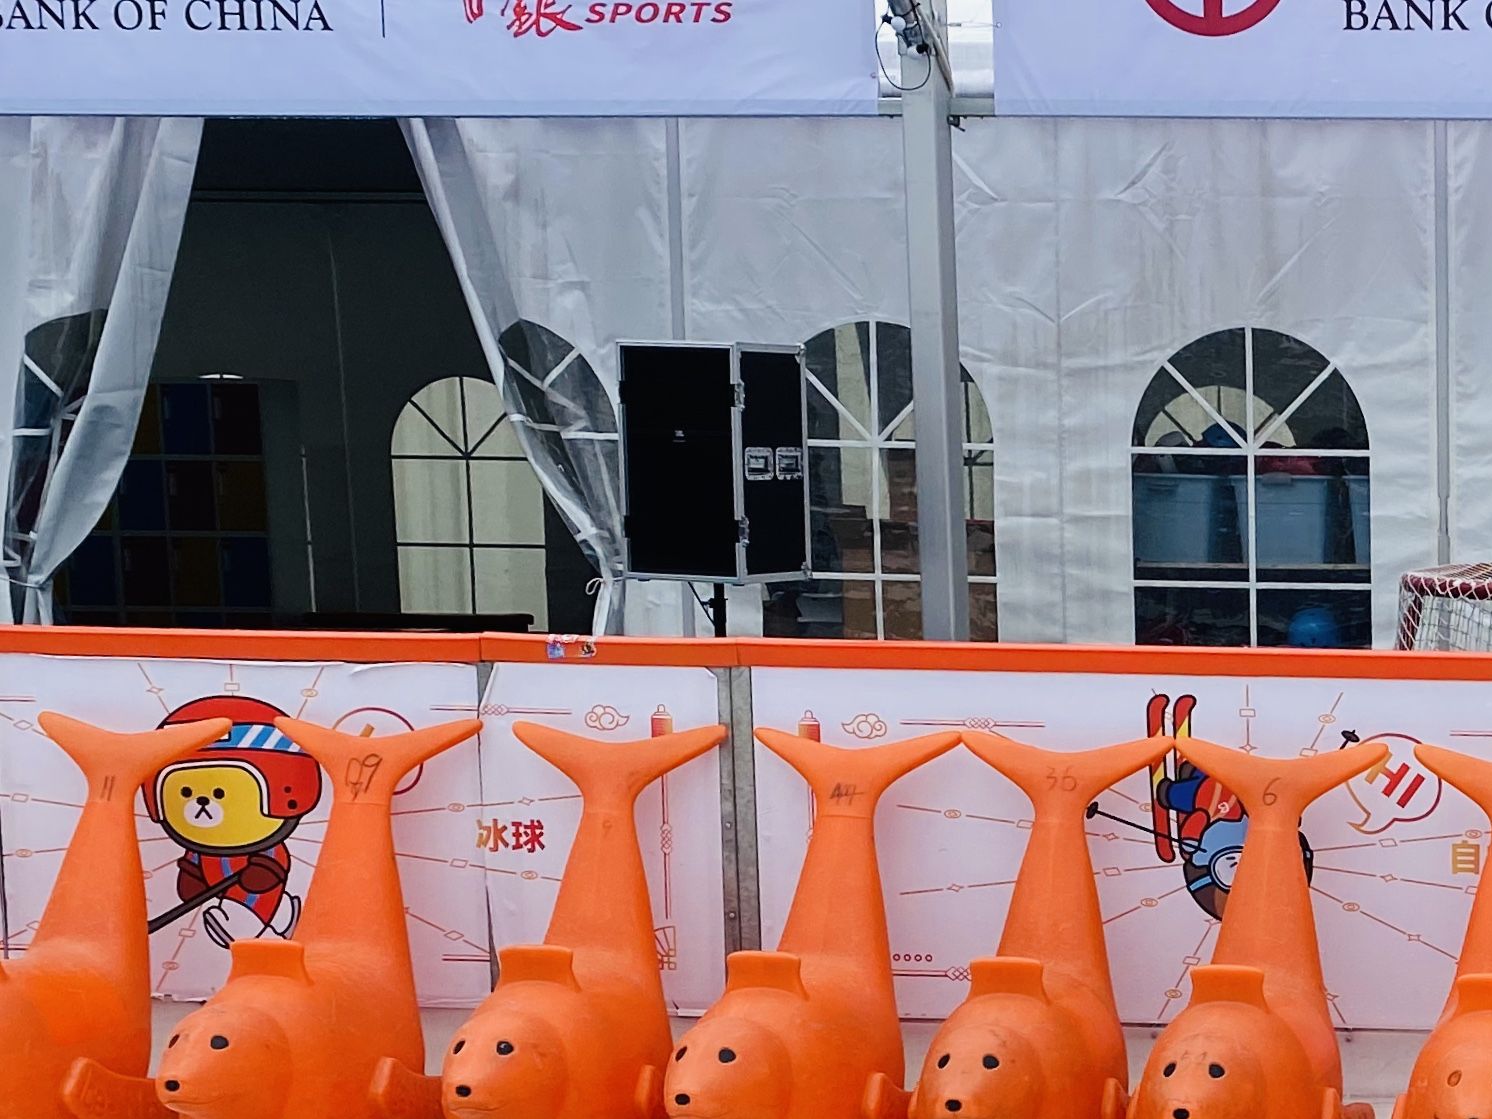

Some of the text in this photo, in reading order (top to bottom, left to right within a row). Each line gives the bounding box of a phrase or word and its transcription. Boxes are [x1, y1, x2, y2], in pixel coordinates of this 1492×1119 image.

[0, 0, 334, 31] ANK OF CHINA
[585, 2, 733, 24] SPORTS
[1342, 0, 1470, 31] BANK
[1261, 776, 1281, 807] 6
[1364, 752, 1426, 809] HI
[475, 818, 546, 854] 冰球
